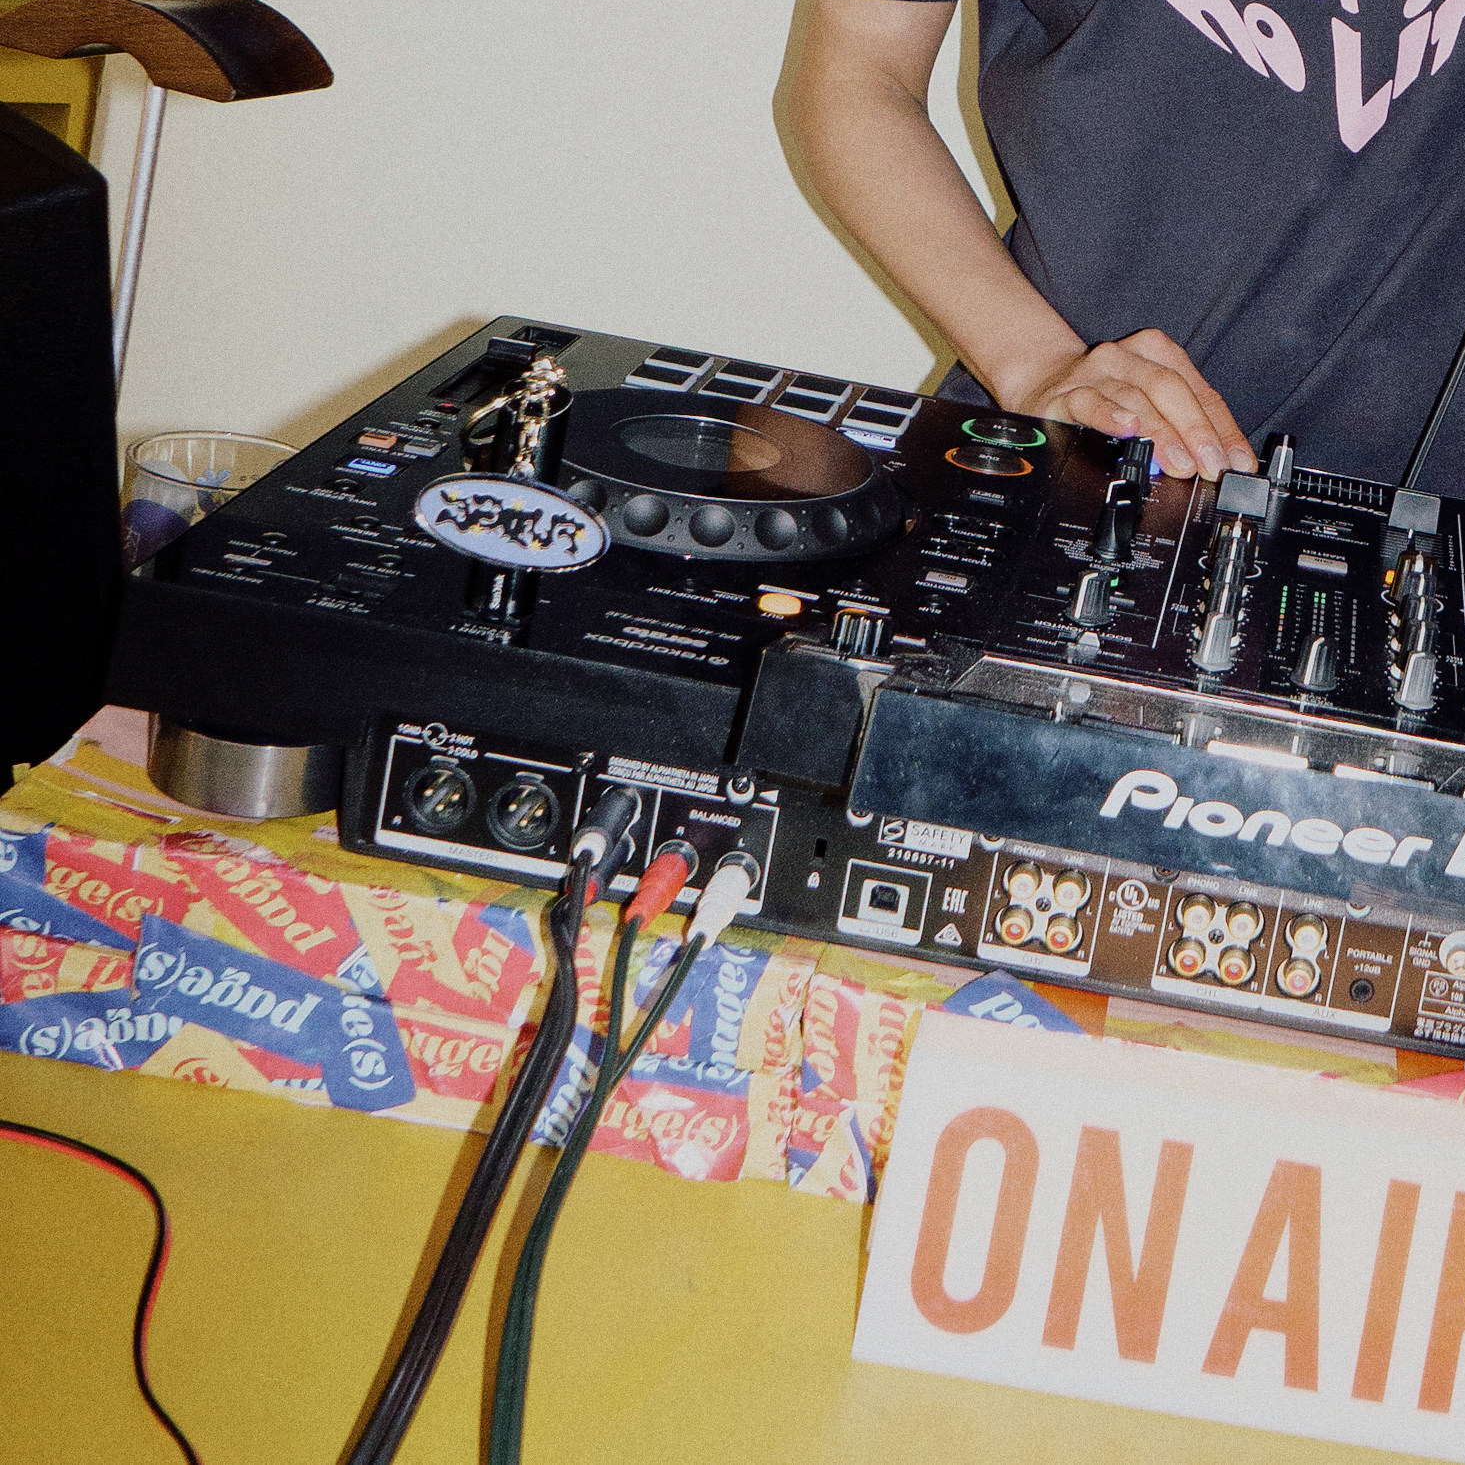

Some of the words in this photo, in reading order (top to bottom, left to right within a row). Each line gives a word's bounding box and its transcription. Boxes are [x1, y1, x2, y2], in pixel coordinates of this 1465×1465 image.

[621, 625, 707, 647] serato
[582, 632, 705, 660] rekordbox
[689, 808, 742, 829] BALANCED
[1099, 769, 1434, 868] Pioneer
[910, 822, 969, 844] SAFETY
[1012, 844, 1047, 859] PHONO
[1187, 876, 1220, 892] PHONO
[1346, 947, 1393, 965] PORTABLE
[1408, 946, 1438, 961] SIGNAL
[1412, 957, 1431, 969] GND
[1312, 1006, 1337, 1020] AUX
[910, 1105, 1195, 1365] ON
